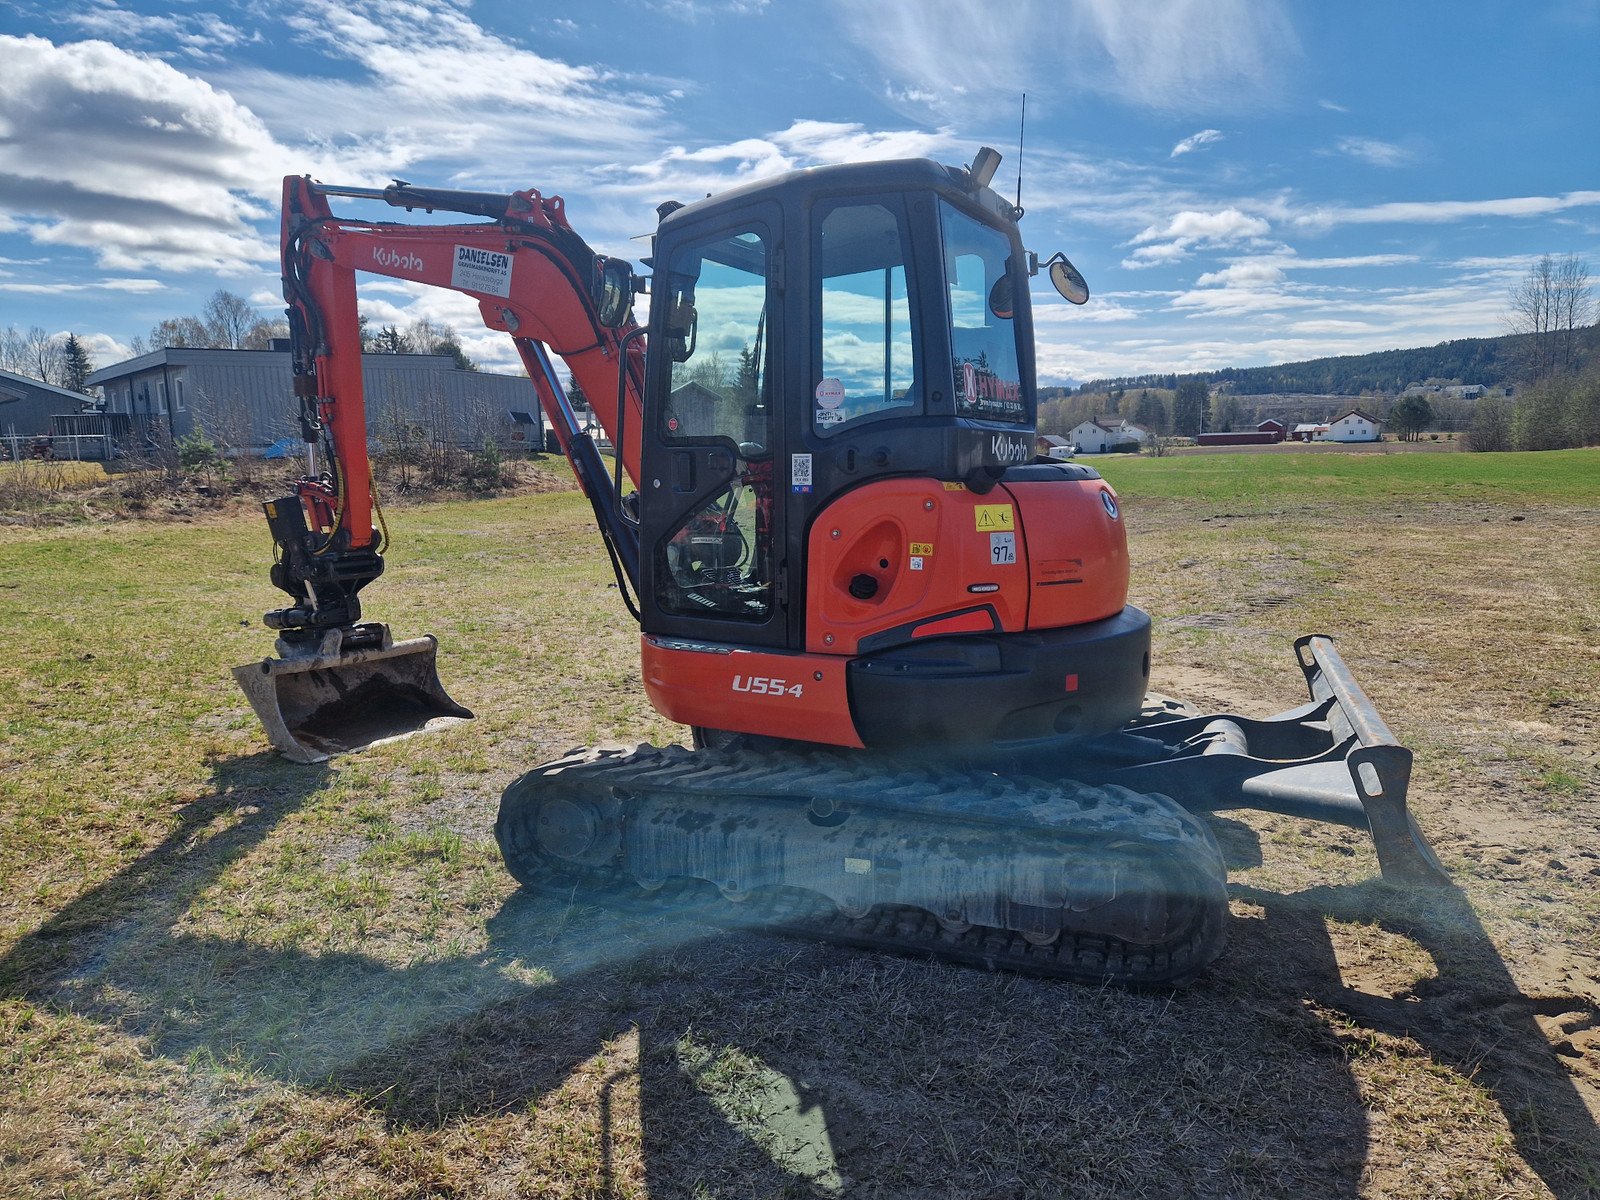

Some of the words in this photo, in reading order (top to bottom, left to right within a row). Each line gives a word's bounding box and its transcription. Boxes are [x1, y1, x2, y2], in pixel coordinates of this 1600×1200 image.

[373, 246, 424, 272] Kubota
[458, 247, 509, 269] DANIELSEN
[501, 269, 508, 277] AS
[991, 435, 1028, 461] Kubota
[993, 546, 1008, 562] 97
